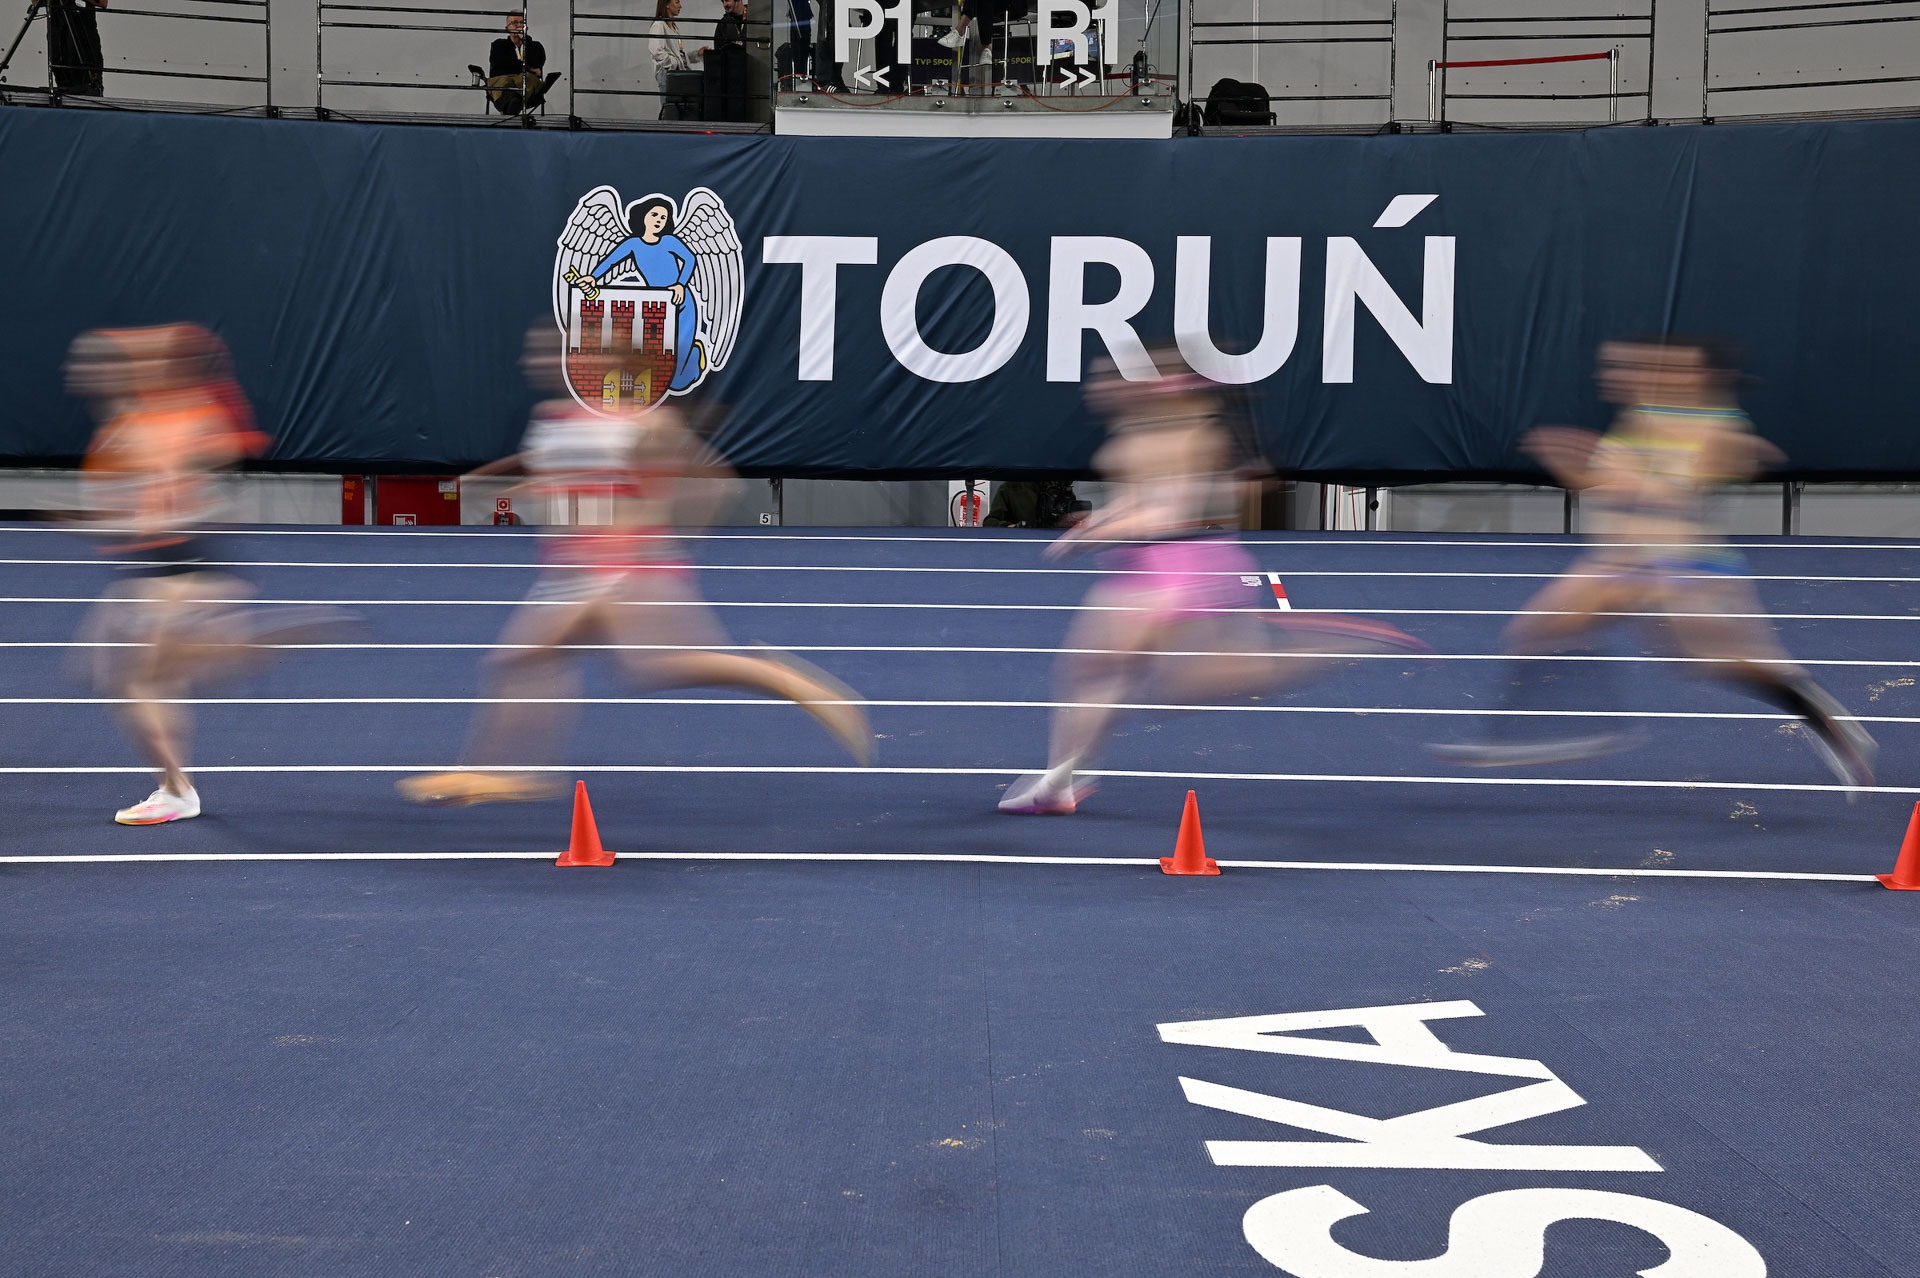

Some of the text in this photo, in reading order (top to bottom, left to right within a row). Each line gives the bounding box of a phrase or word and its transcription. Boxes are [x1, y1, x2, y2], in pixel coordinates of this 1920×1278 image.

[835, 0, 911, 64] P1
[914, 58, 931, 66] TVP
[1037, 0, 1118, 65] R1
[762, 194, 1456, 385] TORUŃ
[762, 514, 769, 524] 5
[1155, 999, 1768, 1278] SKA
